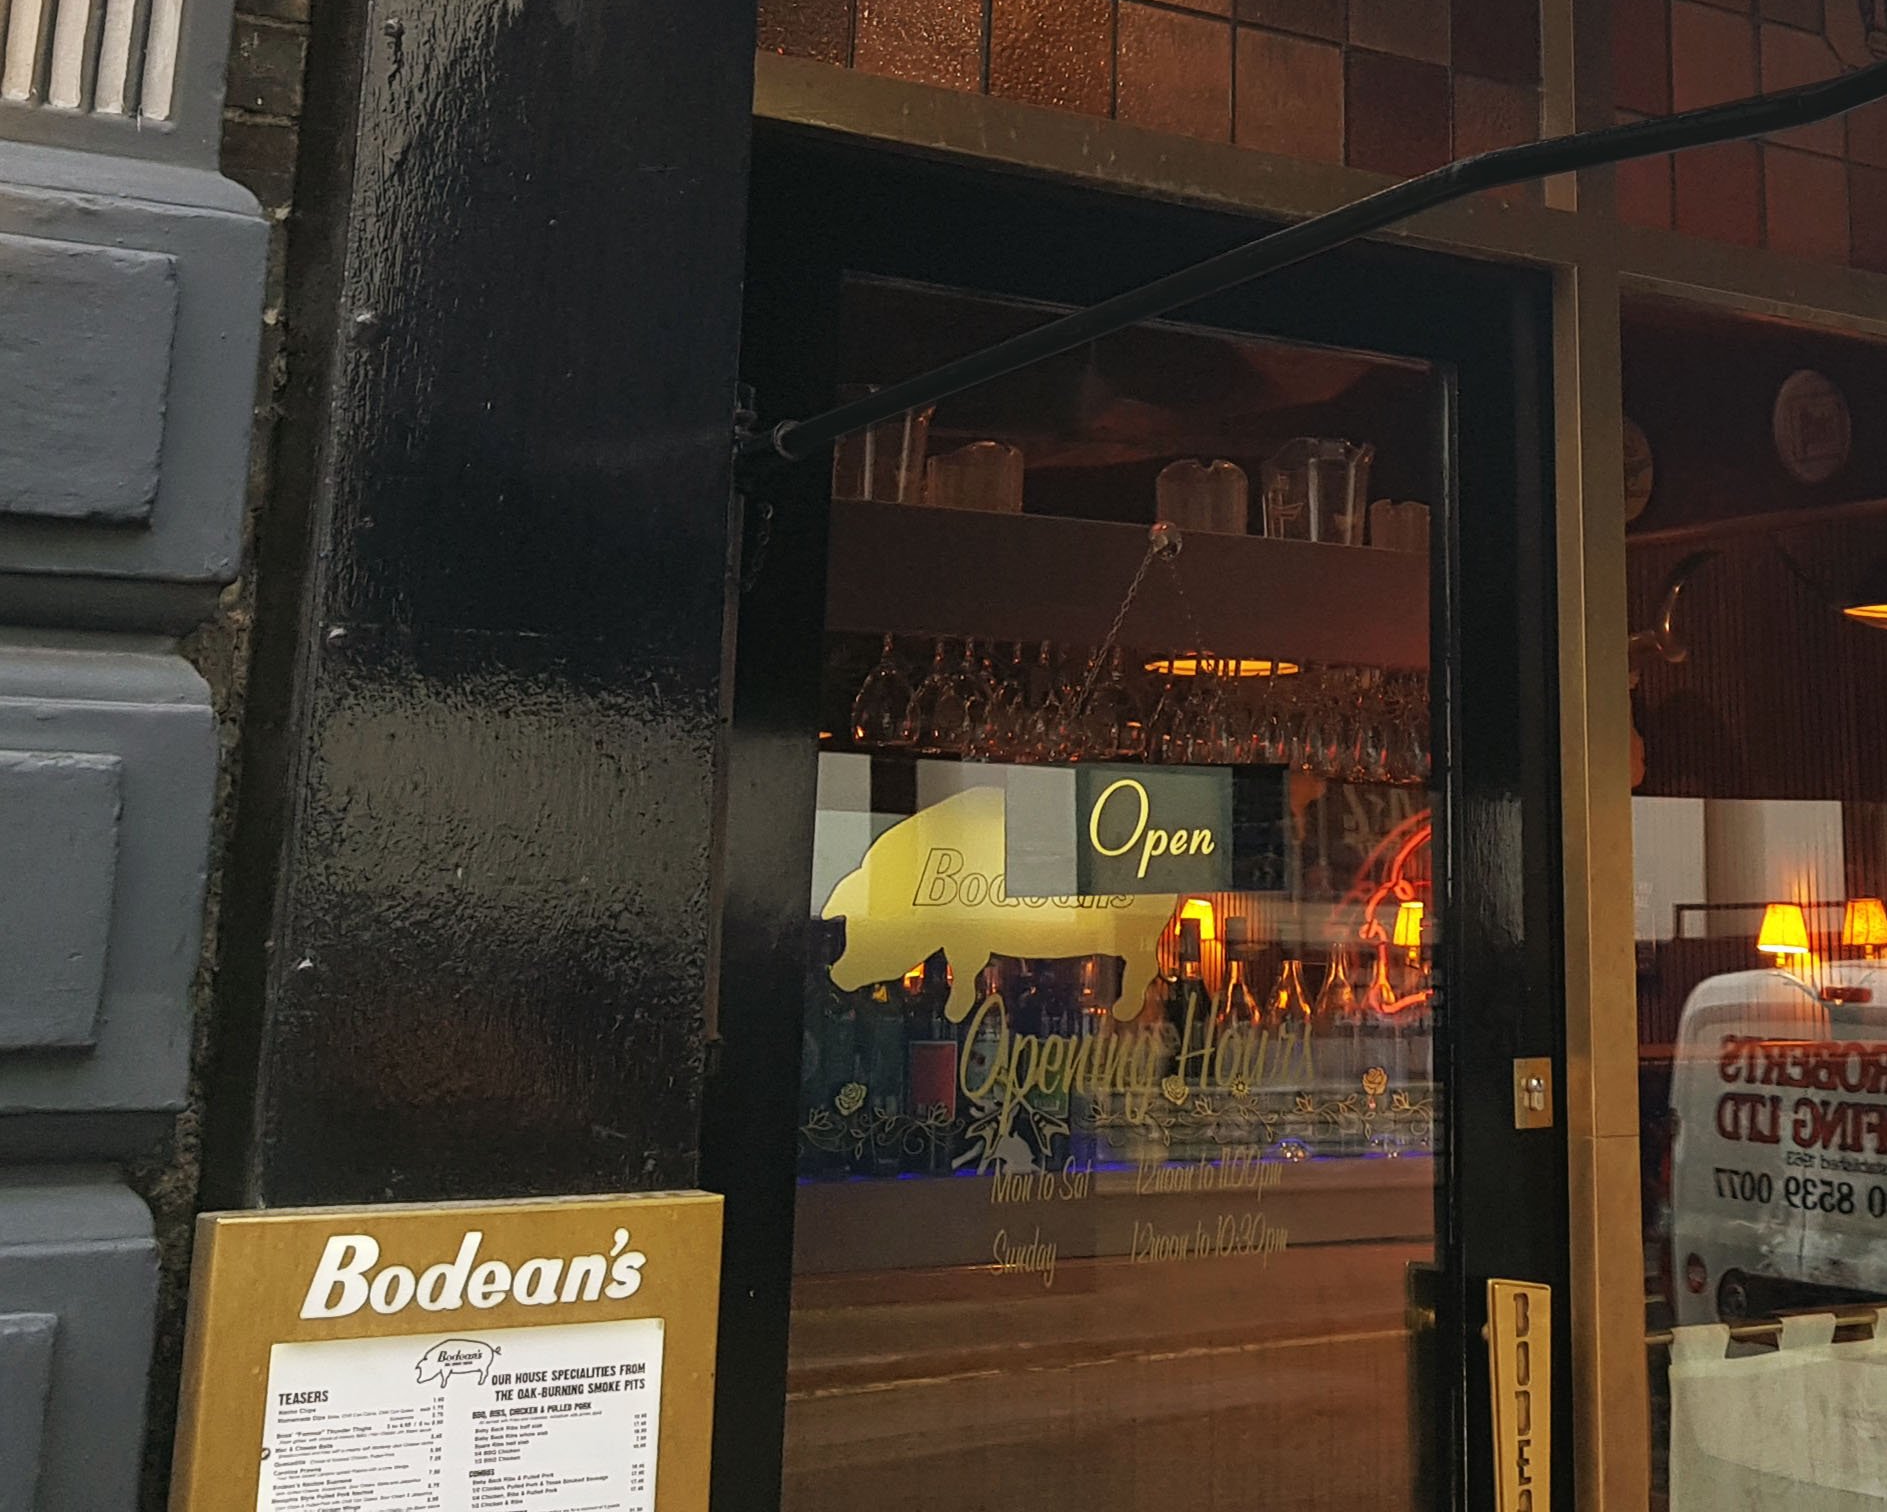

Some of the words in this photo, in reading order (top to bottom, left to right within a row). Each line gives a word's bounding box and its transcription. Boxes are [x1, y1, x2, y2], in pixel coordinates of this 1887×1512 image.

[1089, 778, 1215, 879] Open
[960, 992, 1163, 1125] Opening
[1174, 990, 1315, 1089] Hours
[990, 1165, 1032, 1204] Mon
[1038, 1161, 1055, 1201] to
[1059, 1154, 1094, 1201] Sat
[1199, 1152, 1216, 1190] to
[299, 1226, 648, 1321] Bodean's
[991, 1225, 1057, 1288] Sunday
[1194, 1219, 1211, 1260] to
[278, 1390, 329, 1406] TEASERS
[491, 1373, 512, 1386] OUR
[515, 1370, 548, 1384] HOUSE
[551, 1364, 617, 1381] SPECIALITIES
[619, 1362, 646, 1376] FROM
[495, 1389, 514, 1402] THE
[517, 1383, 584, 1400] OAK-BURNING
[587, 1380, 621, 1394] SMOKE
[624, 1378, 646, 1392] PITS
